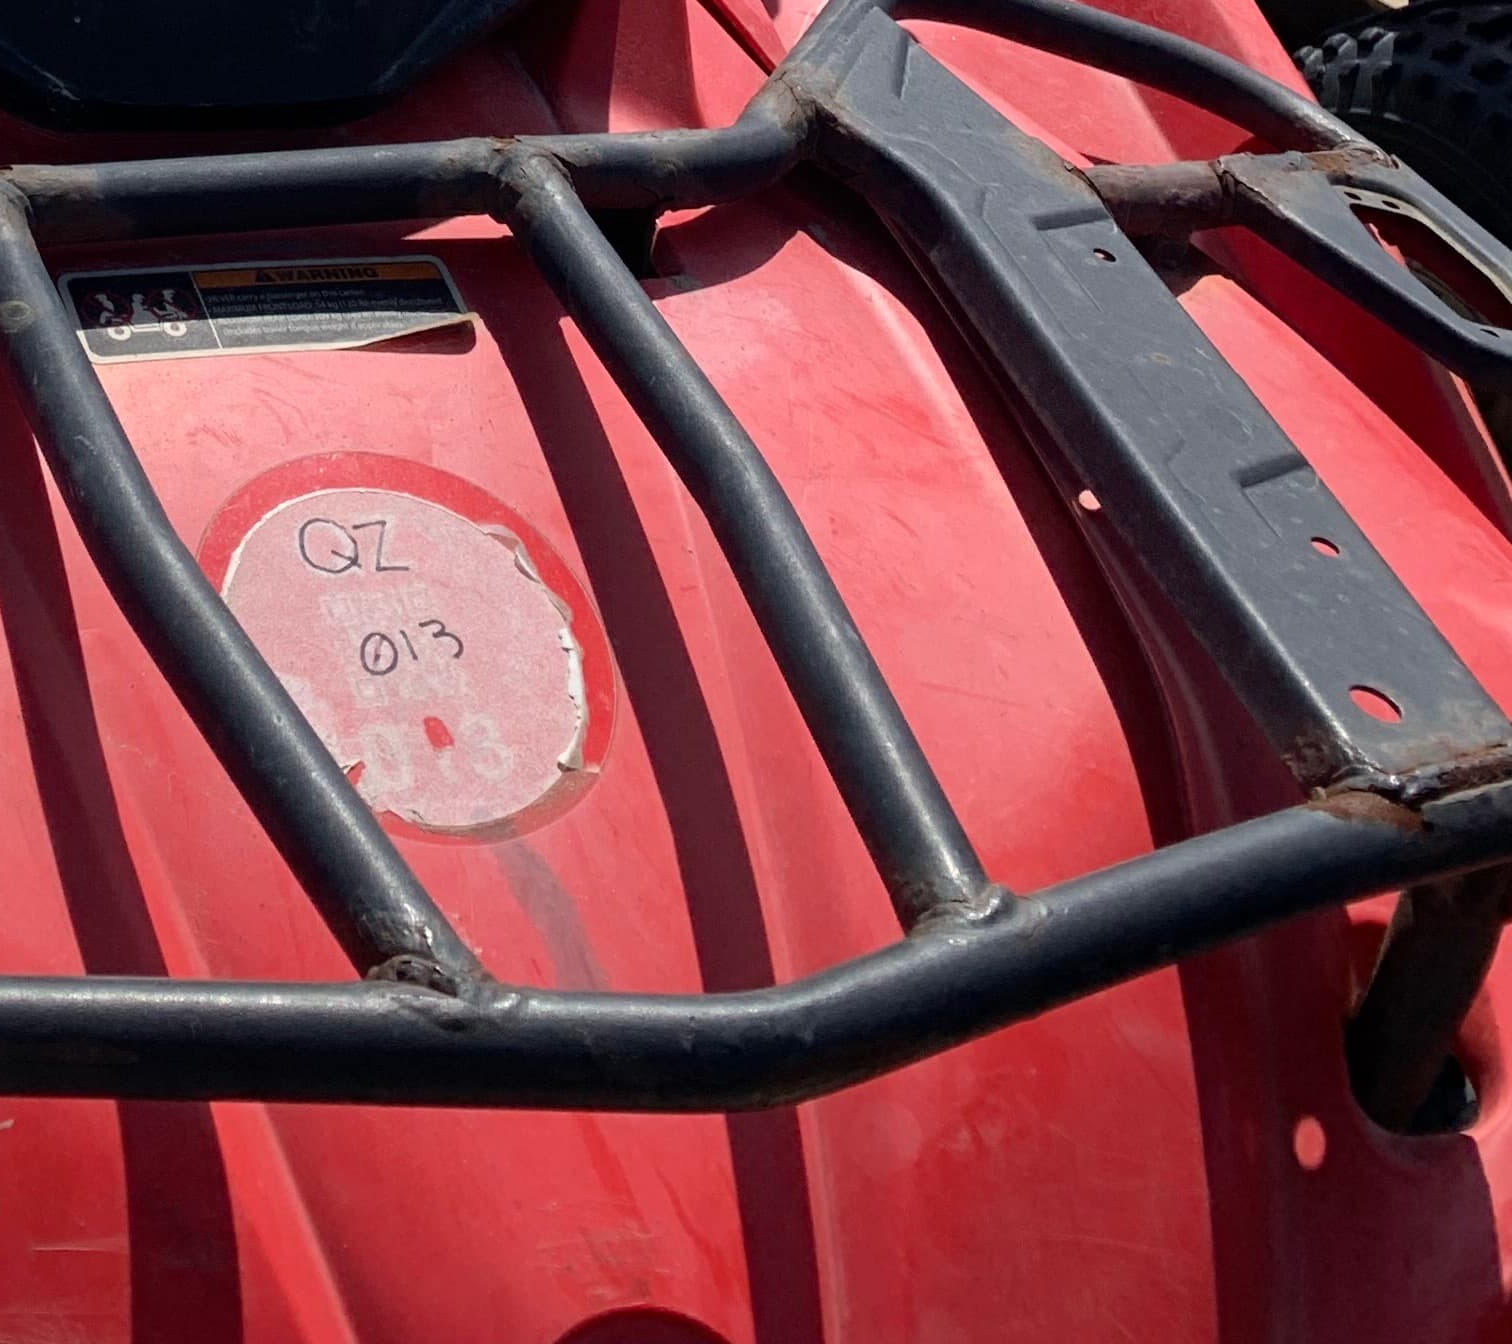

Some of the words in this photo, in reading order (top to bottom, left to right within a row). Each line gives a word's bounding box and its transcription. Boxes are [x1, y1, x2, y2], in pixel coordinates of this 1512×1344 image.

[276, 266, 380, 283] WARNING
[298, 518, 410, 574] QZ
[359, 618, 465, 677] 013
